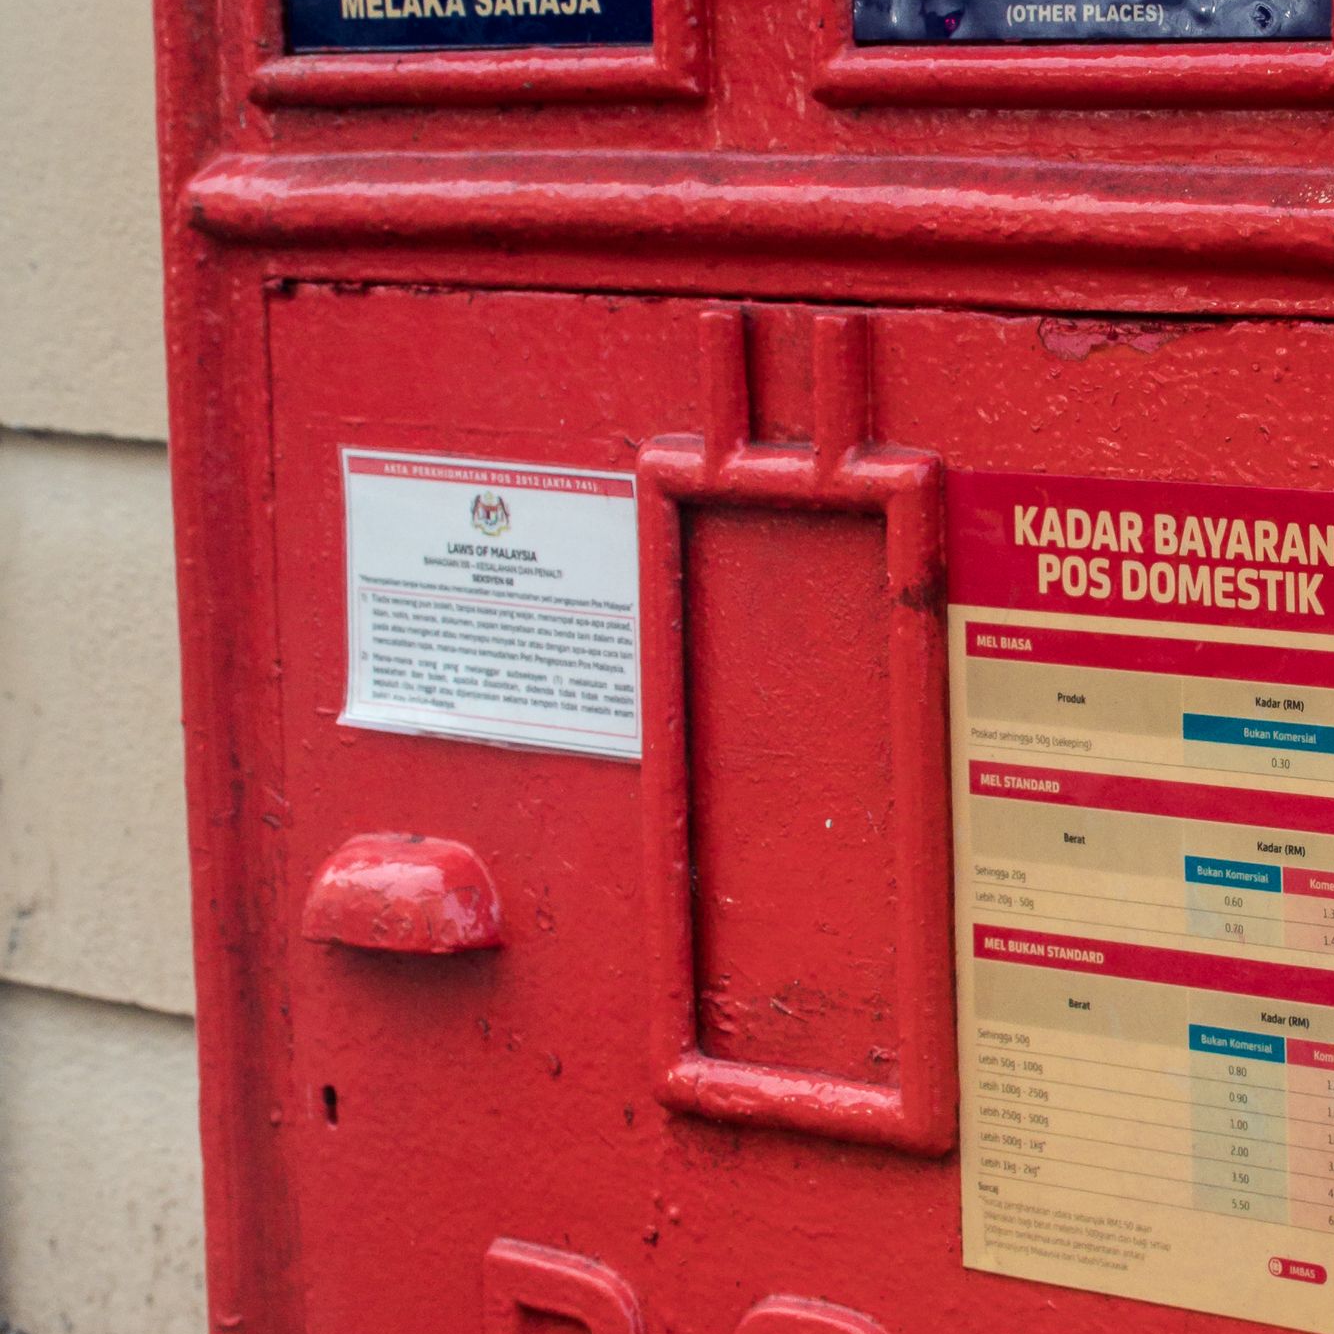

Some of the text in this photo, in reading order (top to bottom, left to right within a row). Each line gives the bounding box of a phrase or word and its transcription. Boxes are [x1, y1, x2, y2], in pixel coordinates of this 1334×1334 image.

[1006, 4, 1164, 23] (OTHER PLACES)
[384, 464, 408, 475] AKTA
[516, 475, 539, 486] 2012
[543, 477, 572, 488] (AKTA
[1014, 505, 1144, 554] KADAR
[447, 542, 538, 562] LAWS OF MALAYSIA
[1038, 553, 1325, 616] POS DOMESTIK
[977, 635, 1032, 651] MEL BIASA
[1057, 692, 1086, 704] Produk
[1255, 697, 1305, 712] Kadar (RM)
[971, 728, 1092, 751] Poskad sehingga 50g (sekeping)
[1244, 727, 1317, 744] Bukan Komersial
[1272, 757, 1290, 769] 0.30
[980, 774, 1060, 793] MEL STANDARD
[1064, 833, 1086, 844] Berat
[1257, 841, 1306, 857] Kadar (RM)
[975, 865, 1026, 883] Sehingga 20g
[1197, 866, 1269, 884] Bukan Komersial
[976, 891, 996, 903] Lebih
[1019, 897, 1034, 910] 50g
[1224, 896, 1243, 908] 0.60
[1225, 922, 1244, 934] 0.70
[984, 937, 1104, 964] MEL BUKAN STANDARD
[1068, 999, 1090, 1011] Berat
[1261, 1012, 1310, 1029] Kadar (RM)
[978, 1028, 1030, 1047] Sehingga 50g
[1201, 1034, 1272, 1054] Bukan Komersial
[978, 1054, 998, 1066] Lebih
[1000, 1057, 1015, 1071] 50g
[1023, 1061, 1043, 1075] 100g
[1228, 1065, 1247, 1077] 0.80
[979, 1081, 999, 1092] Lebih
[1001, 1083, 1021, 1098] 100g
[1028, 1087, 1048, 1102] 250g
[1229, 1092, 1247, 1104] 0.90
[980, 1106, 1000, 1118] Lebih
[1001, 1109, 1022, 1123] 250g
[1029, 1113, 1049, 1127] 500g
[1230, 1119, 1248, 1131] 1.00
[980, 1132, 1000, 1143] Lebih
[1002, 1134, 1022, 1149] 500g
[1231, 1146, 1248, 1157] 2.00
[981, 1157, 1000, 1168] Lebih
[1002, 1160, 1016, 1174] 1kg
[1232, 1173, 1249, 1184] 3.50
[1231, 1199, 1250, 1211] 5.50
[1290, 1266, 1316, 1279] IMBAS
